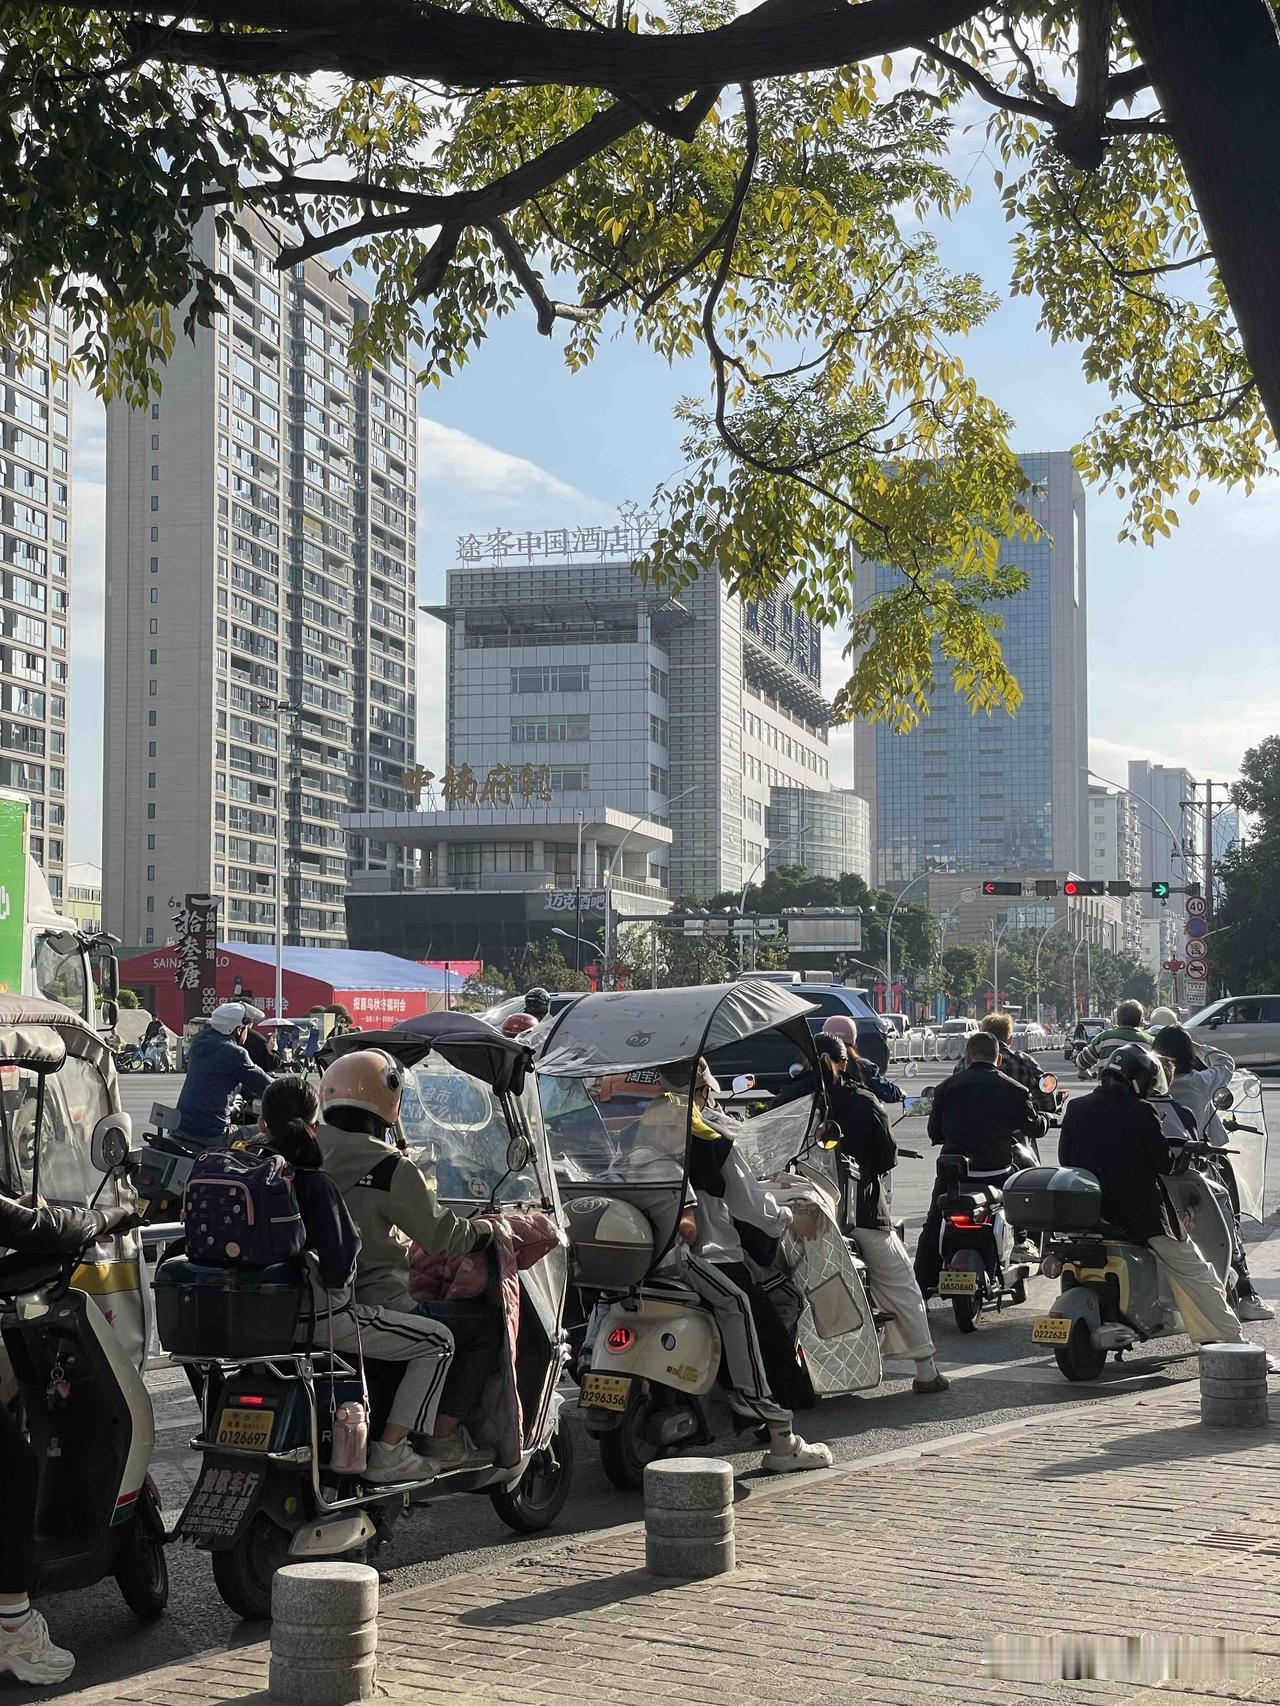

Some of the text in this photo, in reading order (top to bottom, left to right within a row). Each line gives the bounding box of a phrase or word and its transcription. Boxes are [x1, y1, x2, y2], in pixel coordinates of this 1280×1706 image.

[1189, 901, 1203, 912] 40
[353, 997, 407, 1012] 报喜鸟秋冬福利会
[1034, 1329, 1068, 1340] 0222625
[582, 1390, 625, 1405] 0296356
[219, 1430, 268, 1446] 0126697
